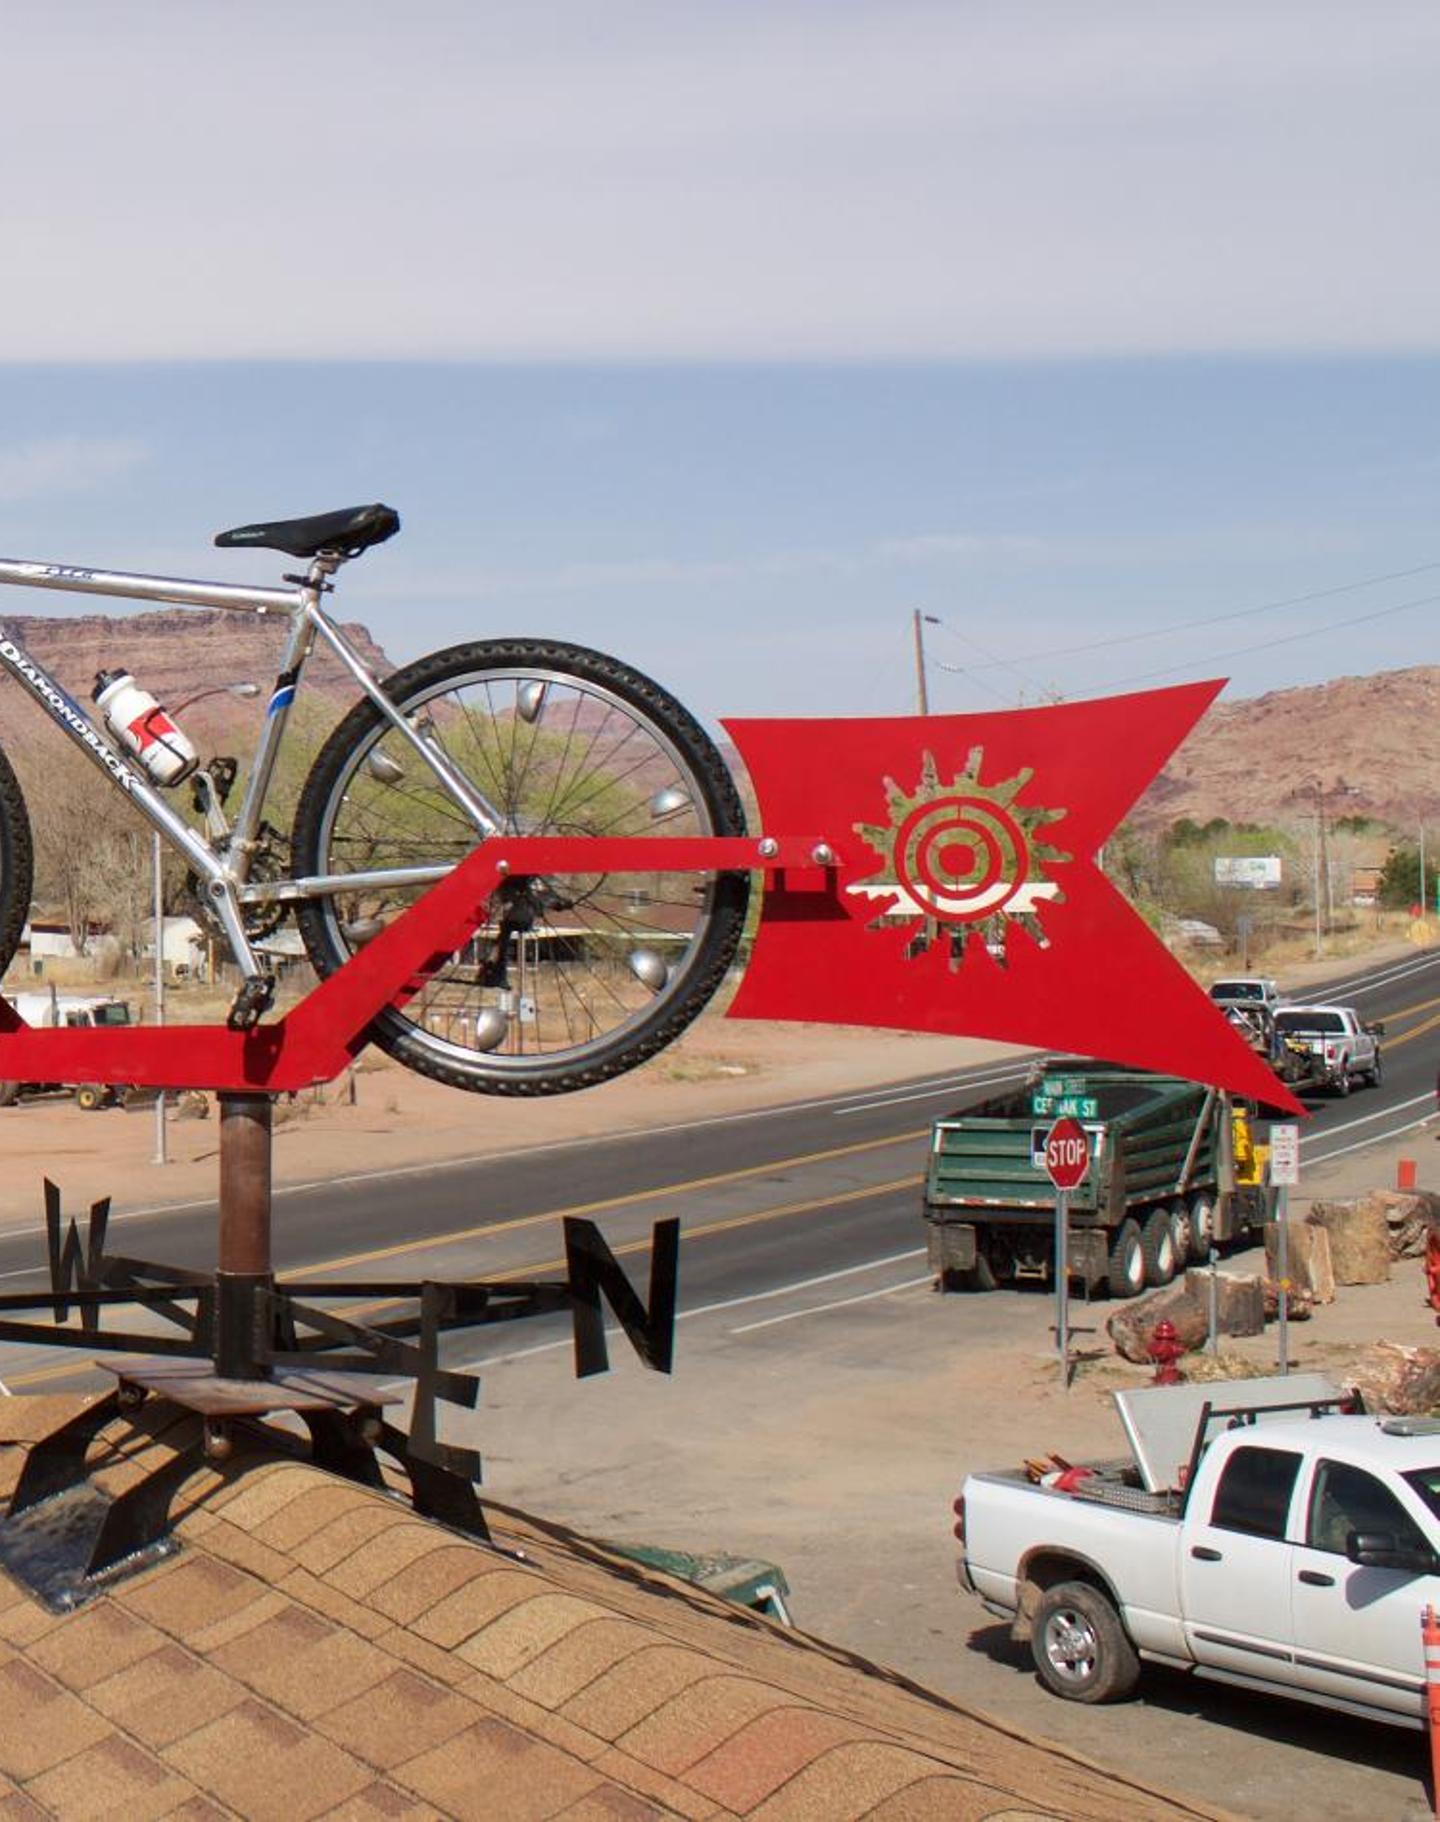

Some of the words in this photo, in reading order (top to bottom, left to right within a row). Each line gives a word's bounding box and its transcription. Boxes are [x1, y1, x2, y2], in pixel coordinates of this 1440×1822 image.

[1082, 1099, 1098, 1118] ST
[1049, 1139, 1086, 1168] STOP
[563, 1216, 680, 1379] N
